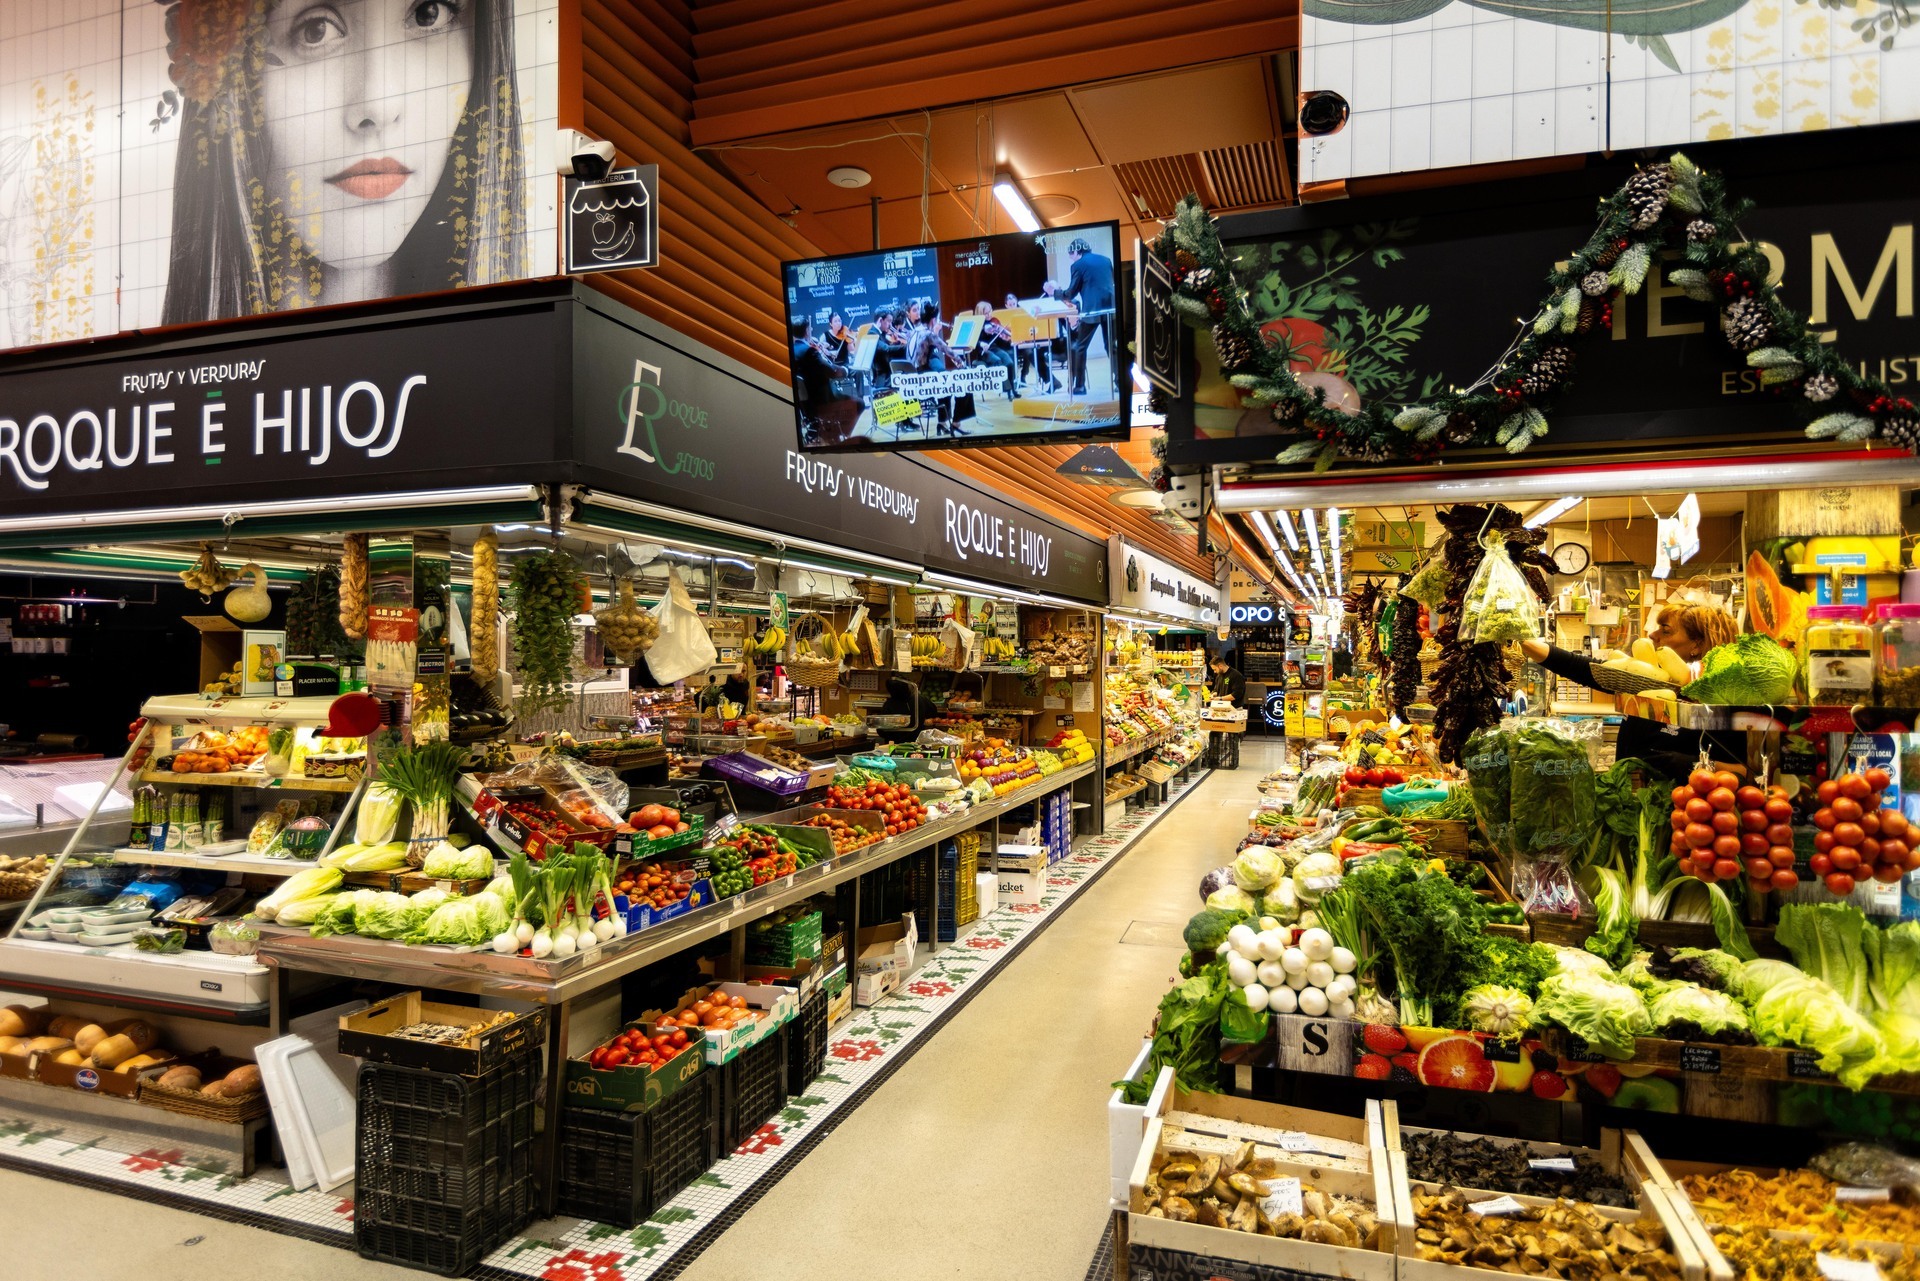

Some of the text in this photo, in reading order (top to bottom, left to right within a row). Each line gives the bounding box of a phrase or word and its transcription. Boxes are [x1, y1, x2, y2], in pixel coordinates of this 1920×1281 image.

[968, 255, 988, 268] paz
[820, 275, 841, 285] RIDAD
[123, 359, 266, 393] FRUTAS Y VERDURAS
[892, 367, 1005, 386] Compra y consigue
[903, 380, 1000, 397] tu entrada doble
[874, 400, 885, 408] LIVE
[876, 402, 900, 413] CONCERT
[878, 409, 895, 419] TICKET
[0, 402, 176, 490] ROQUE
[255, 374, 427, 466] HIJOS
[786, 449, 920, 524] FRUTAS Y VERDURAS
[945, 497, 1004, 560] ROQUE
[1020, 527, 1052, 577] HIJOS
[1230, 606, 1273, 622] OPO
[1875, 750, 1892, 758] LOCAL
[998, 881, 1024, 892] icket
[1302, 1022, 1329, 1057] S
[679, 1057, 699, 1082] CASI
[567, 1080, 596, 1096] CASI
